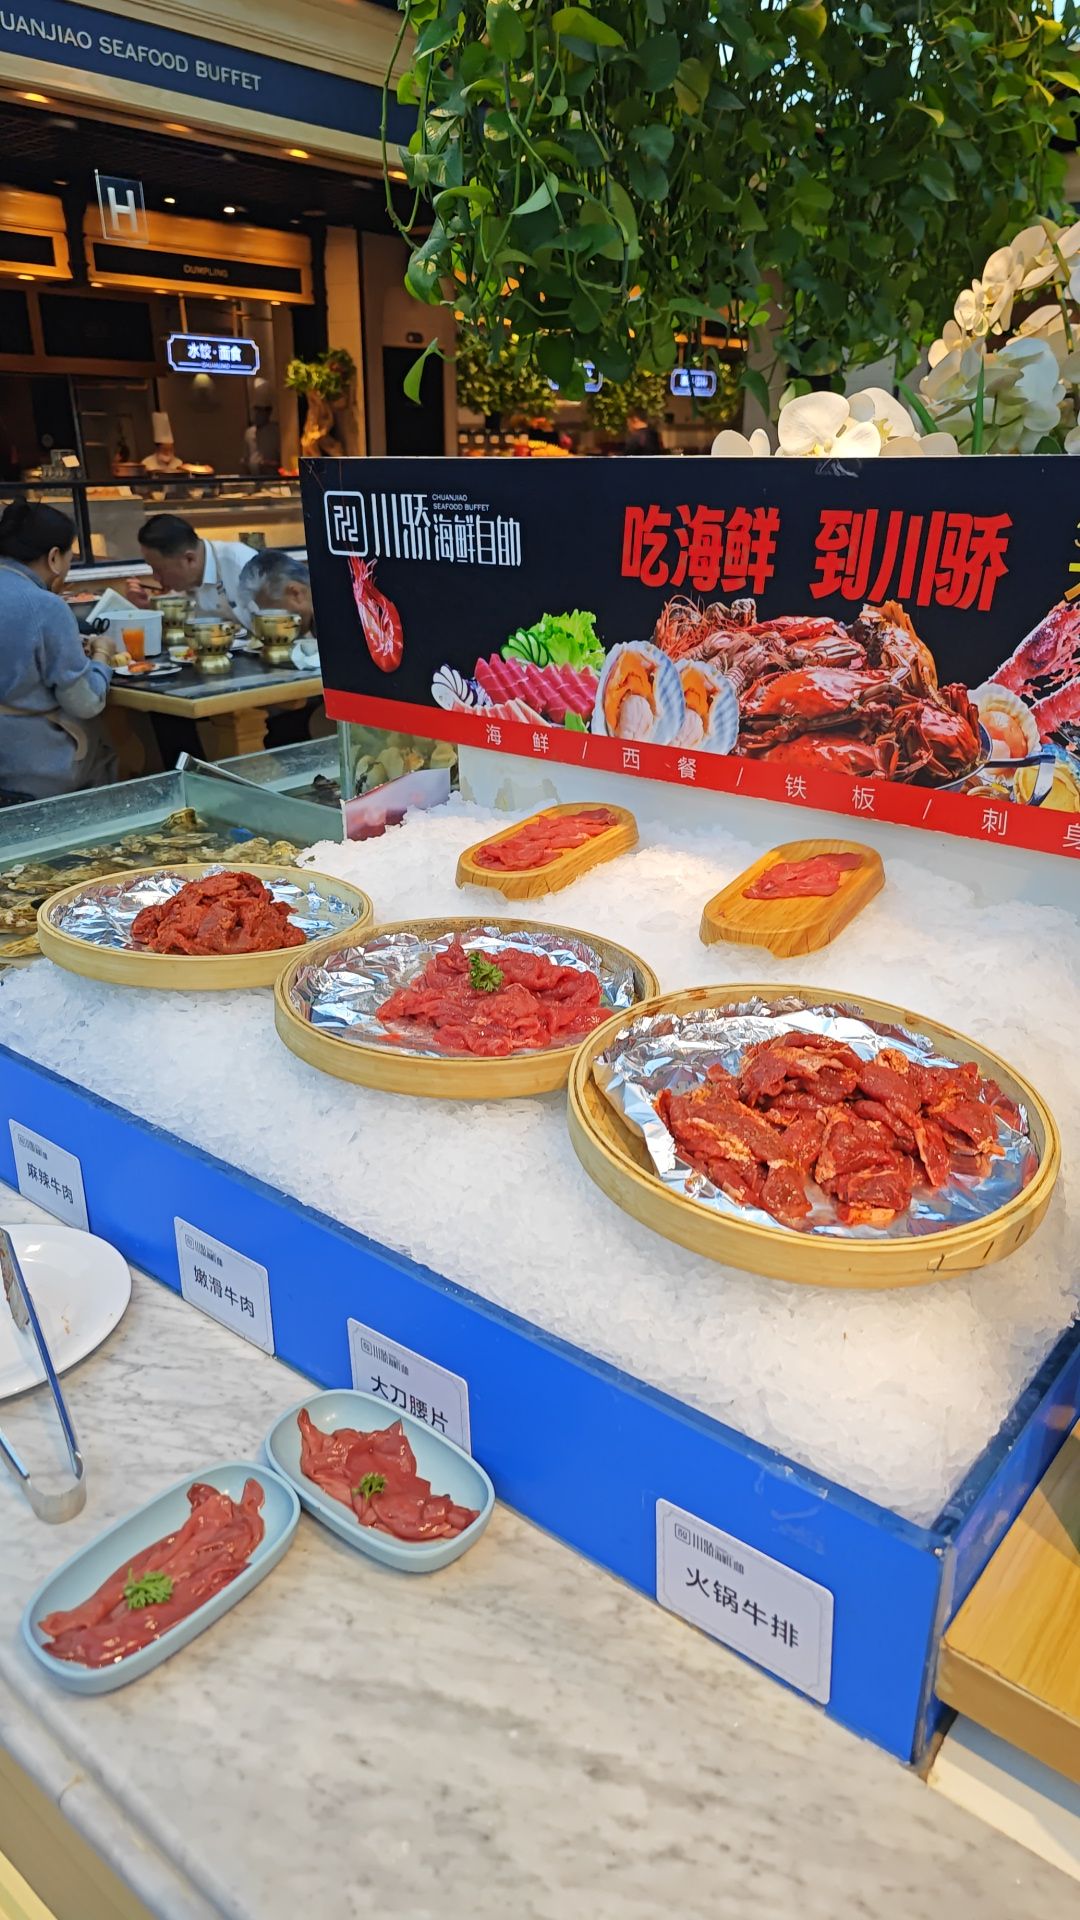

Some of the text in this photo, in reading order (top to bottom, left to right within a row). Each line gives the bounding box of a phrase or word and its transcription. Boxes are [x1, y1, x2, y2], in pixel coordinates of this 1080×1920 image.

[99, 36, 189, 73] SEAFOOD
[195, 60, 262, 91] BUFFET
[107, 186, 138, 233] H
[432, 494, 468, 502] CHUANJIAO
[433, 503, 490, 512] SEAFOOD BUFFET
[621, 504, 1014, 612] 吃海鲜 到川骄
[27, 1162, 74, 1204] 麻辣牛肉
[194, 1265, 255, 1318] 嫩滑牛肉
[371, 1375, 449, 1433] 大刀腰片
[685, 1567, 800, 1648] 火锅牛排
